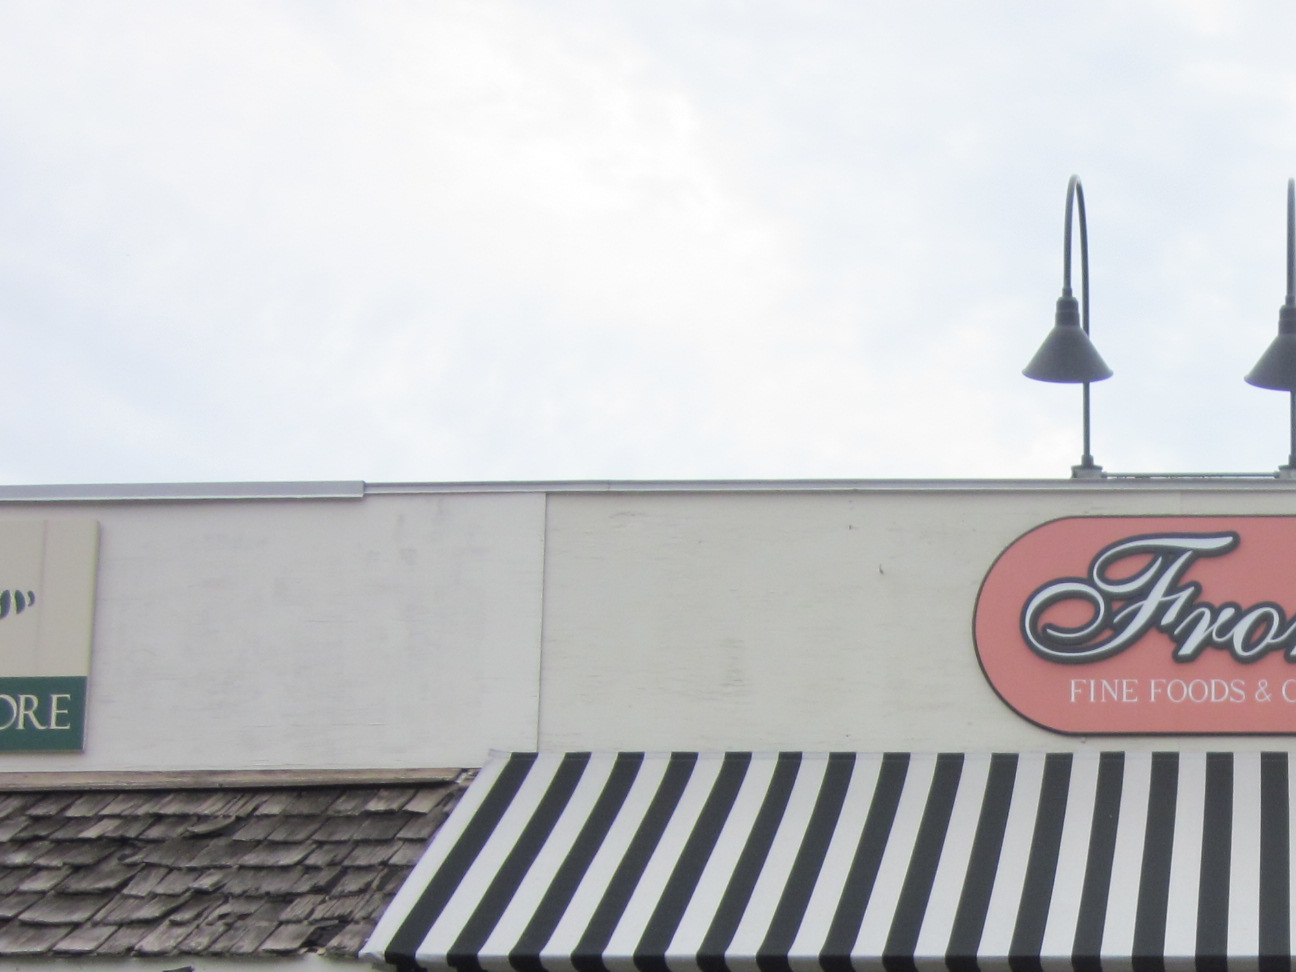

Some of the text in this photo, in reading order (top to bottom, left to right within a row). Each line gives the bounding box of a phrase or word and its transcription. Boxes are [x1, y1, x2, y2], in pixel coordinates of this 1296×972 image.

[1069, 680, 1138, 703] FINE
[1150, 680, 1246, 703] FOODS
[1257, 680, 1273, 703] &
